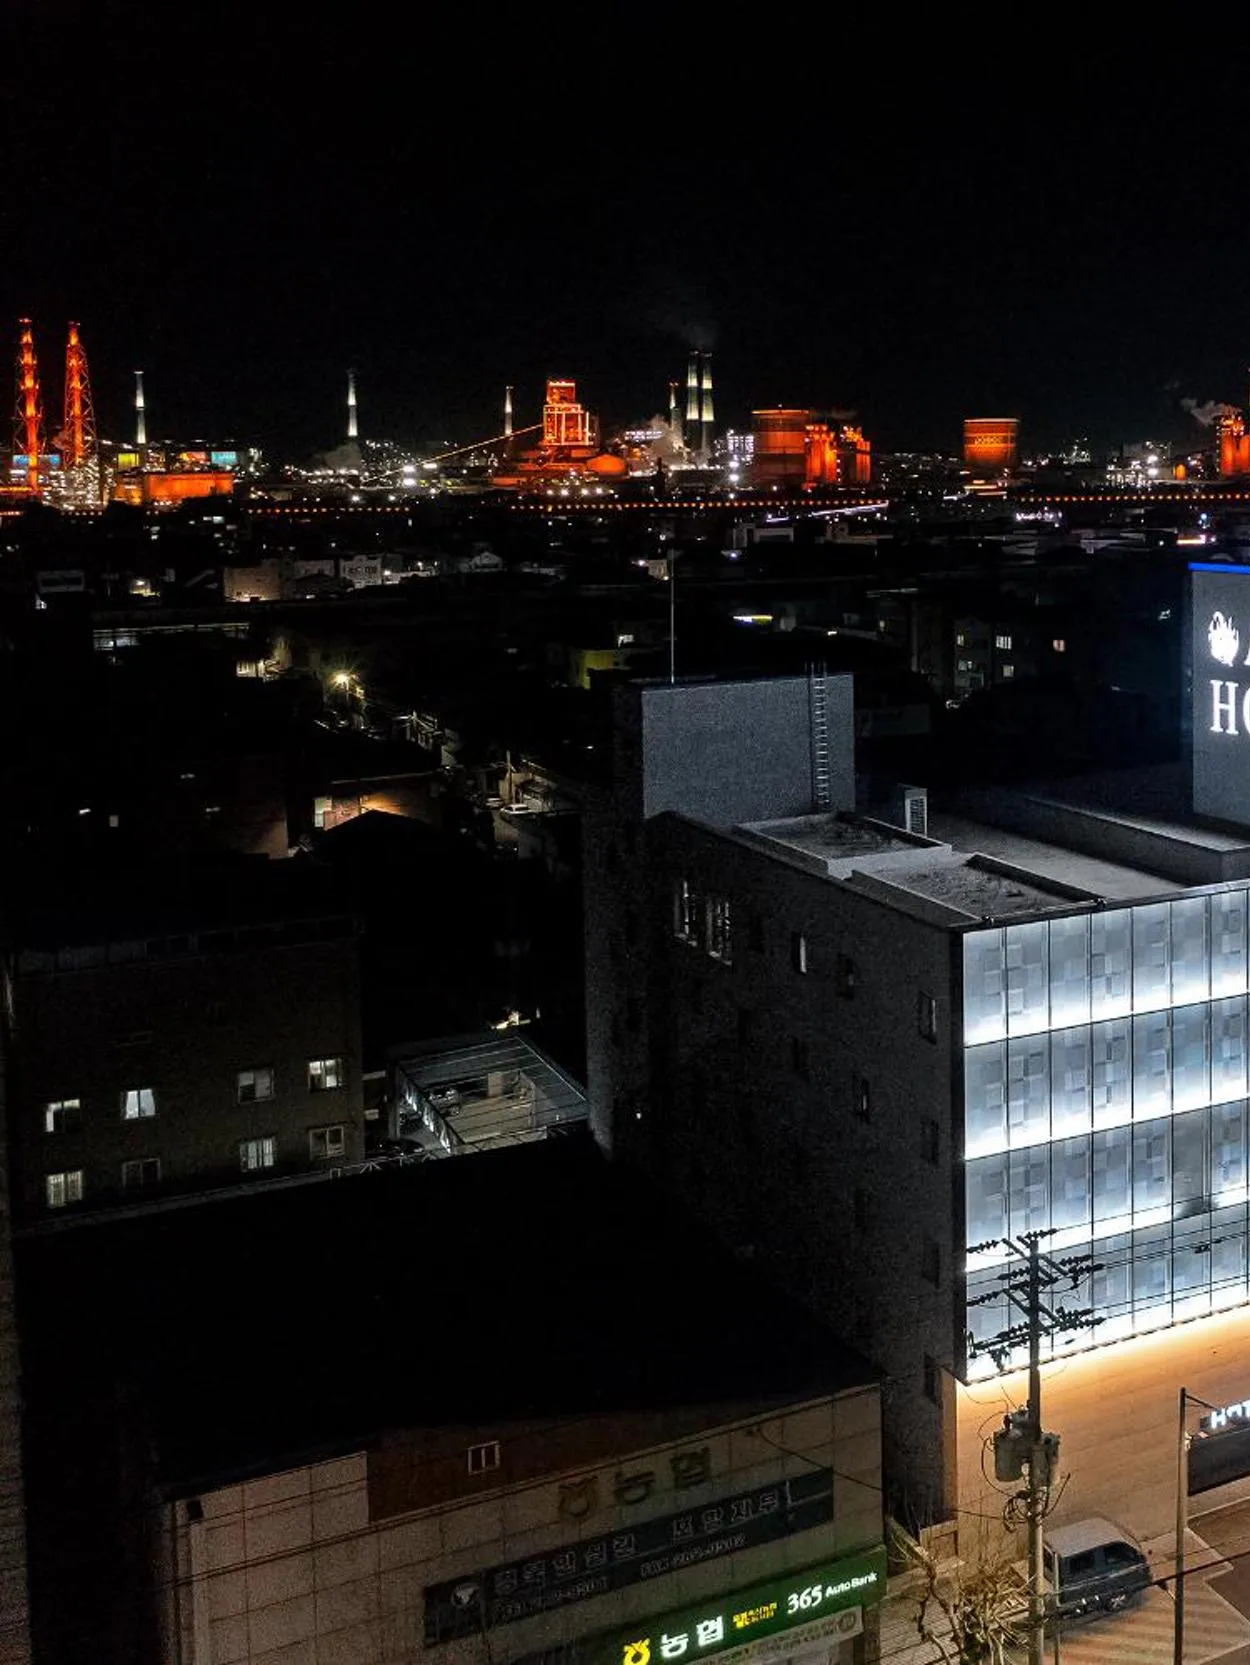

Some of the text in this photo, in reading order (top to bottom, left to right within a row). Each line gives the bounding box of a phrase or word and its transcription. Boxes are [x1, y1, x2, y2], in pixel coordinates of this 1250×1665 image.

[614, 1446, 711, 1504] 농협
[660, 1615, 724, 1659] 농협
[787, 1584, 823, 1615] 365
